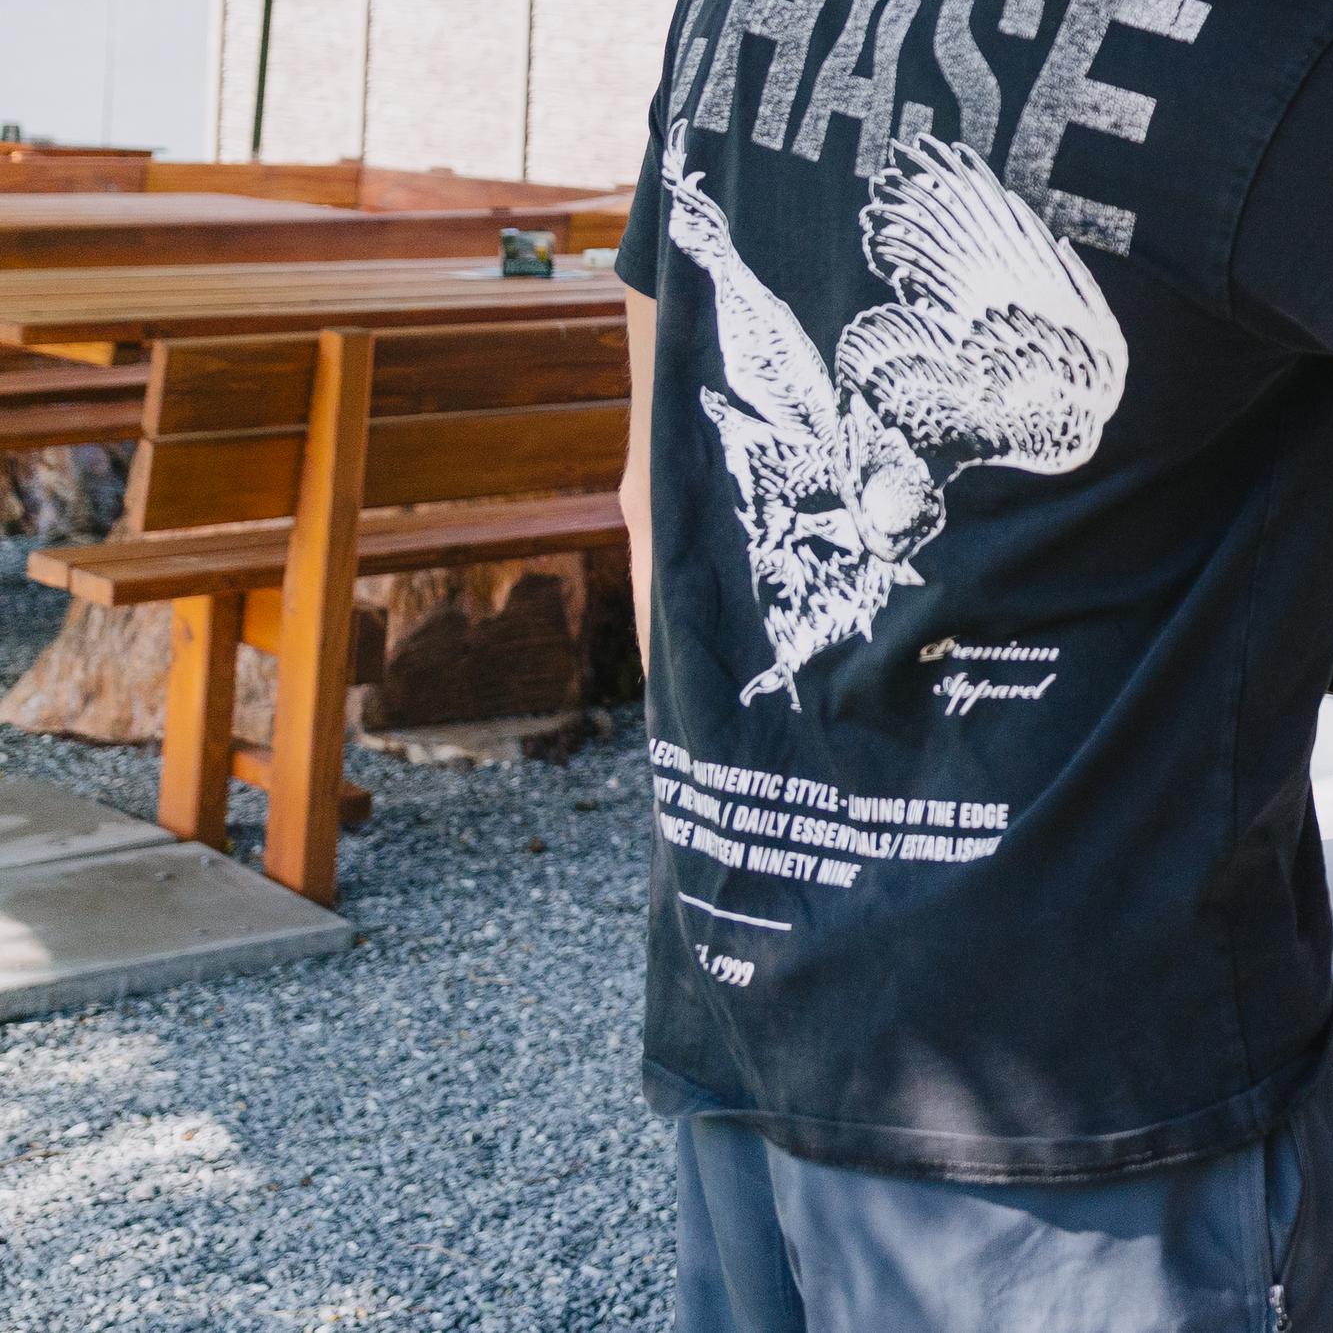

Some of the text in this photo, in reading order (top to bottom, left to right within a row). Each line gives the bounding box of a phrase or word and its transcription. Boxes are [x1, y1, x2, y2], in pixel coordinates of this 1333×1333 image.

[919, 636, 1060, 663] Premium
[933, 673, 1057, 717] Apparel
[783, 776, 839, 813] STYLE
[848, 794, 906, 825] LIVING
[926, 799, 957, 828] THE
[958, 802, 1009, 830] EDGE
[732, 805, 791, 839] DAILY
[789, 815, 893, 859] ESSENTIALS
[746, 844, 819, 882] NINETY
[817, 857, 863, 889] NINE
[710, 954, 755, 988] 1999
